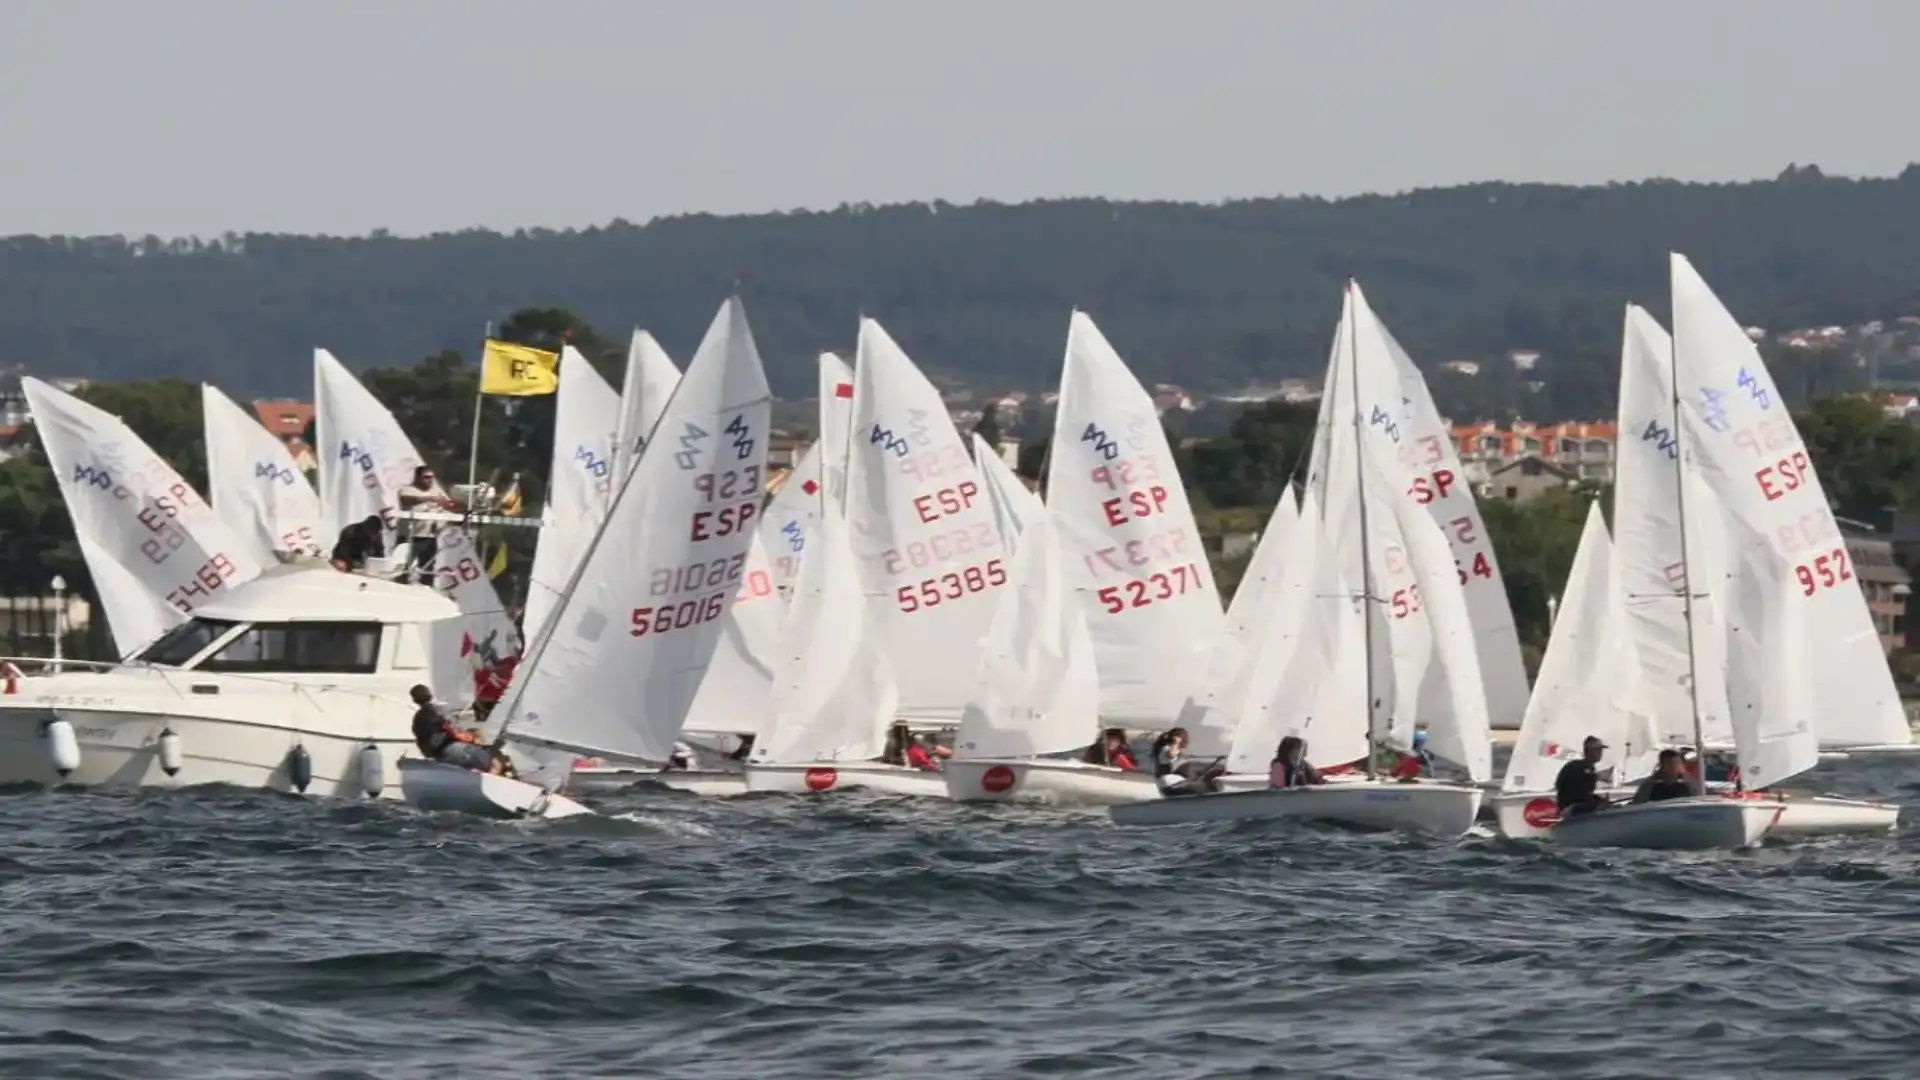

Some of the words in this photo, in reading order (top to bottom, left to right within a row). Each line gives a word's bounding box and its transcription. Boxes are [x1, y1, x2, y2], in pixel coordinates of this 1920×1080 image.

[511, 359, 538, 380] RC
[1738, 366, 1771, 410] 420
[724, 414, 755, 460] 420
[868, 424, 908, 457] 420
[1081, 422, 1118, 460] 420
[576, 445, 607, 477] 420
[1755, 451, 1809, 501] ESP
[137, 483, 188, 532] ESP
[913, 481, 978, 524] ESP
[1102, 485, 1168, 527] ESP
[1408, 469, 1455, 505] SP
[691, 502, 756, 542] ESP
[897, 558, 1008, 613] 55385
[1098, 563, 1203, 614] 52371
[1796, 549, 1852, 597] 952
[630, 592, 725, 637] 56016
